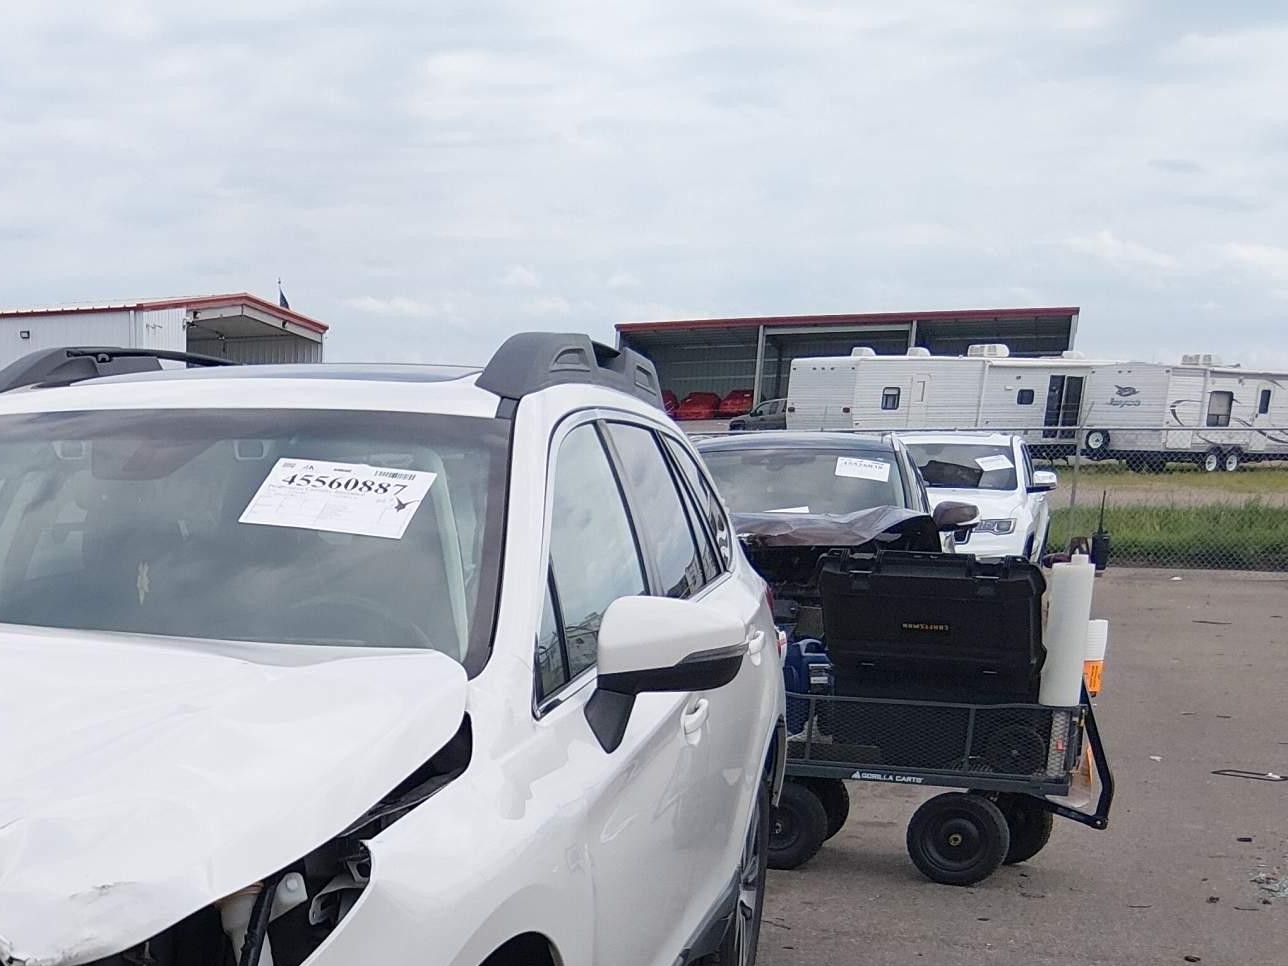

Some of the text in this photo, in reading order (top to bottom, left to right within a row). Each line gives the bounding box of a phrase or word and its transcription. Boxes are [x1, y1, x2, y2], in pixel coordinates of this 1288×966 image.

[1106, 397, 1141, 409] Jayco
[281, 473, 409, 496] 45560887
[861, 772, 893, 781] GORILLA
